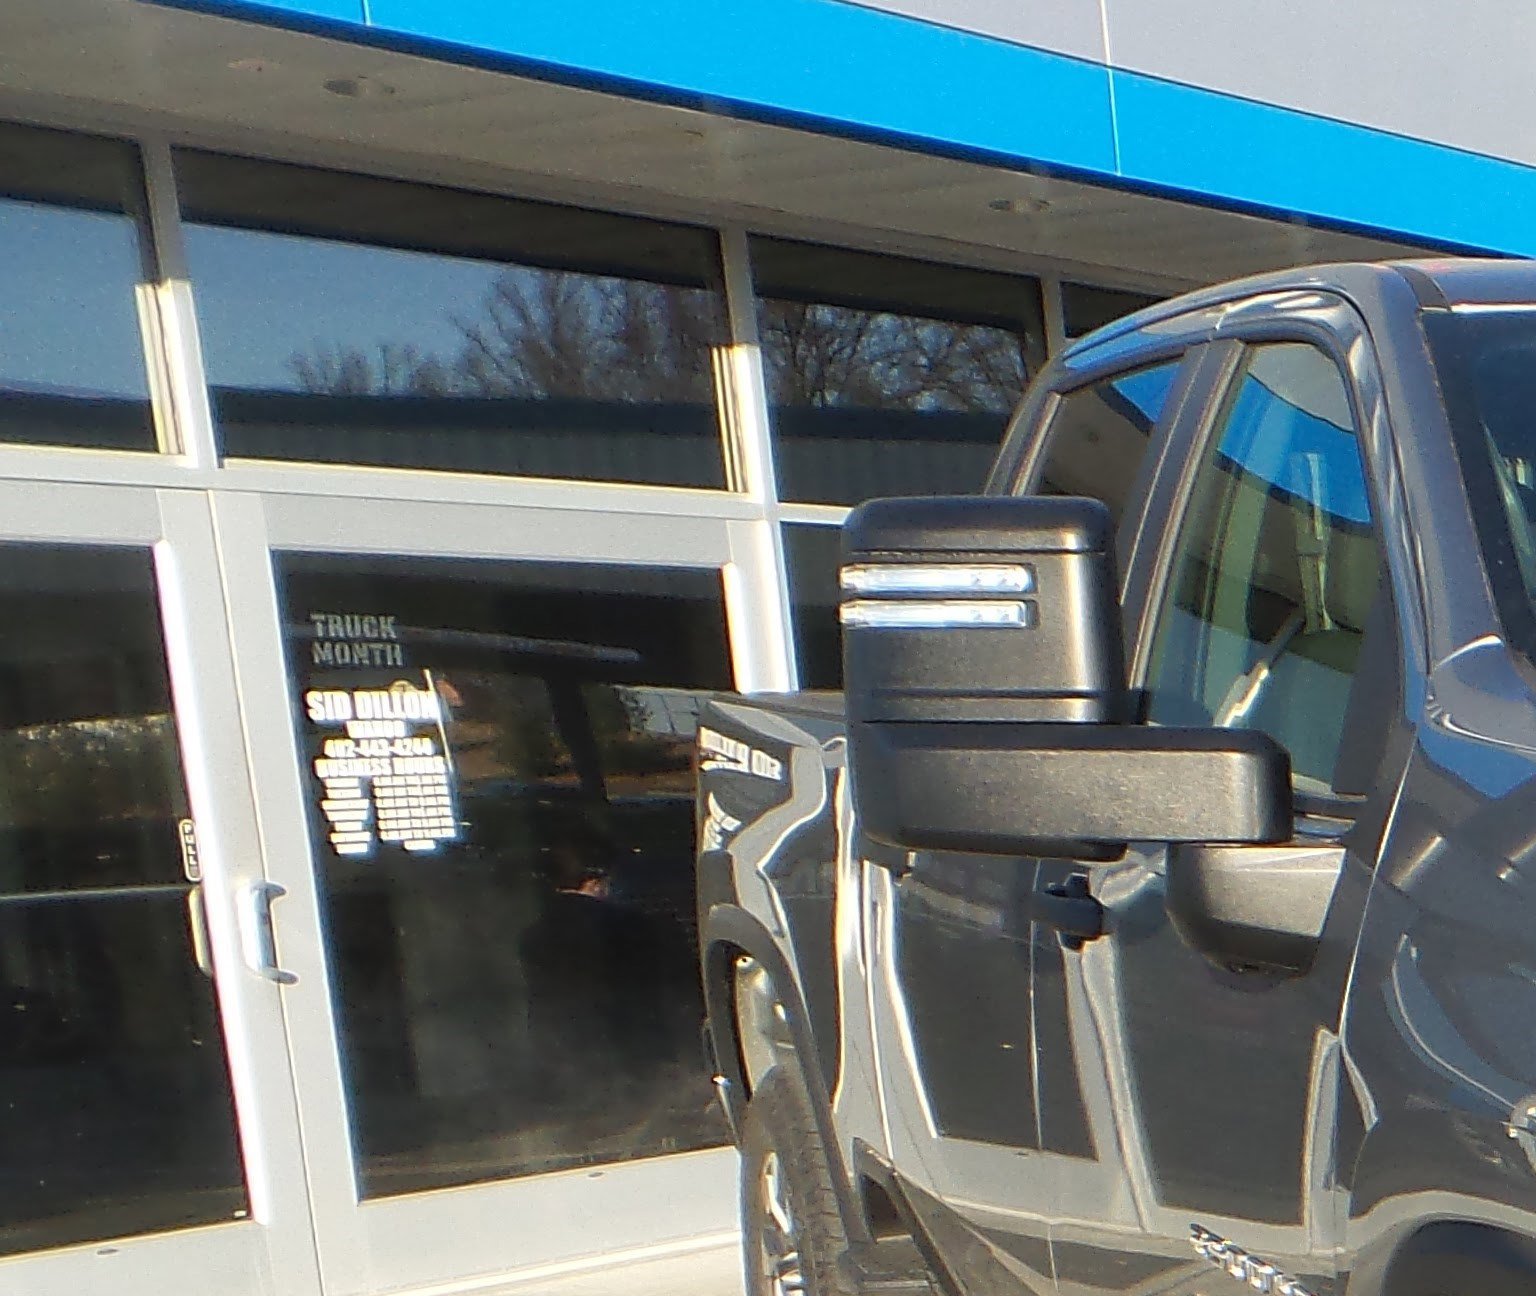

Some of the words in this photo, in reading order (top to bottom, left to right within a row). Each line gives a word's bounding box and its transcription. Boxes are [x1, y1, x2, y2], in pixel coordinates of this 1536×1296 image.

[310, 613, 397, 639] TRUCK
[311, 641, 404, 666] MONTH
[306, 689, 351, 721] SID
[353, 689, 441, 720] DILLON
[184, 823, 198, 865] PULL
